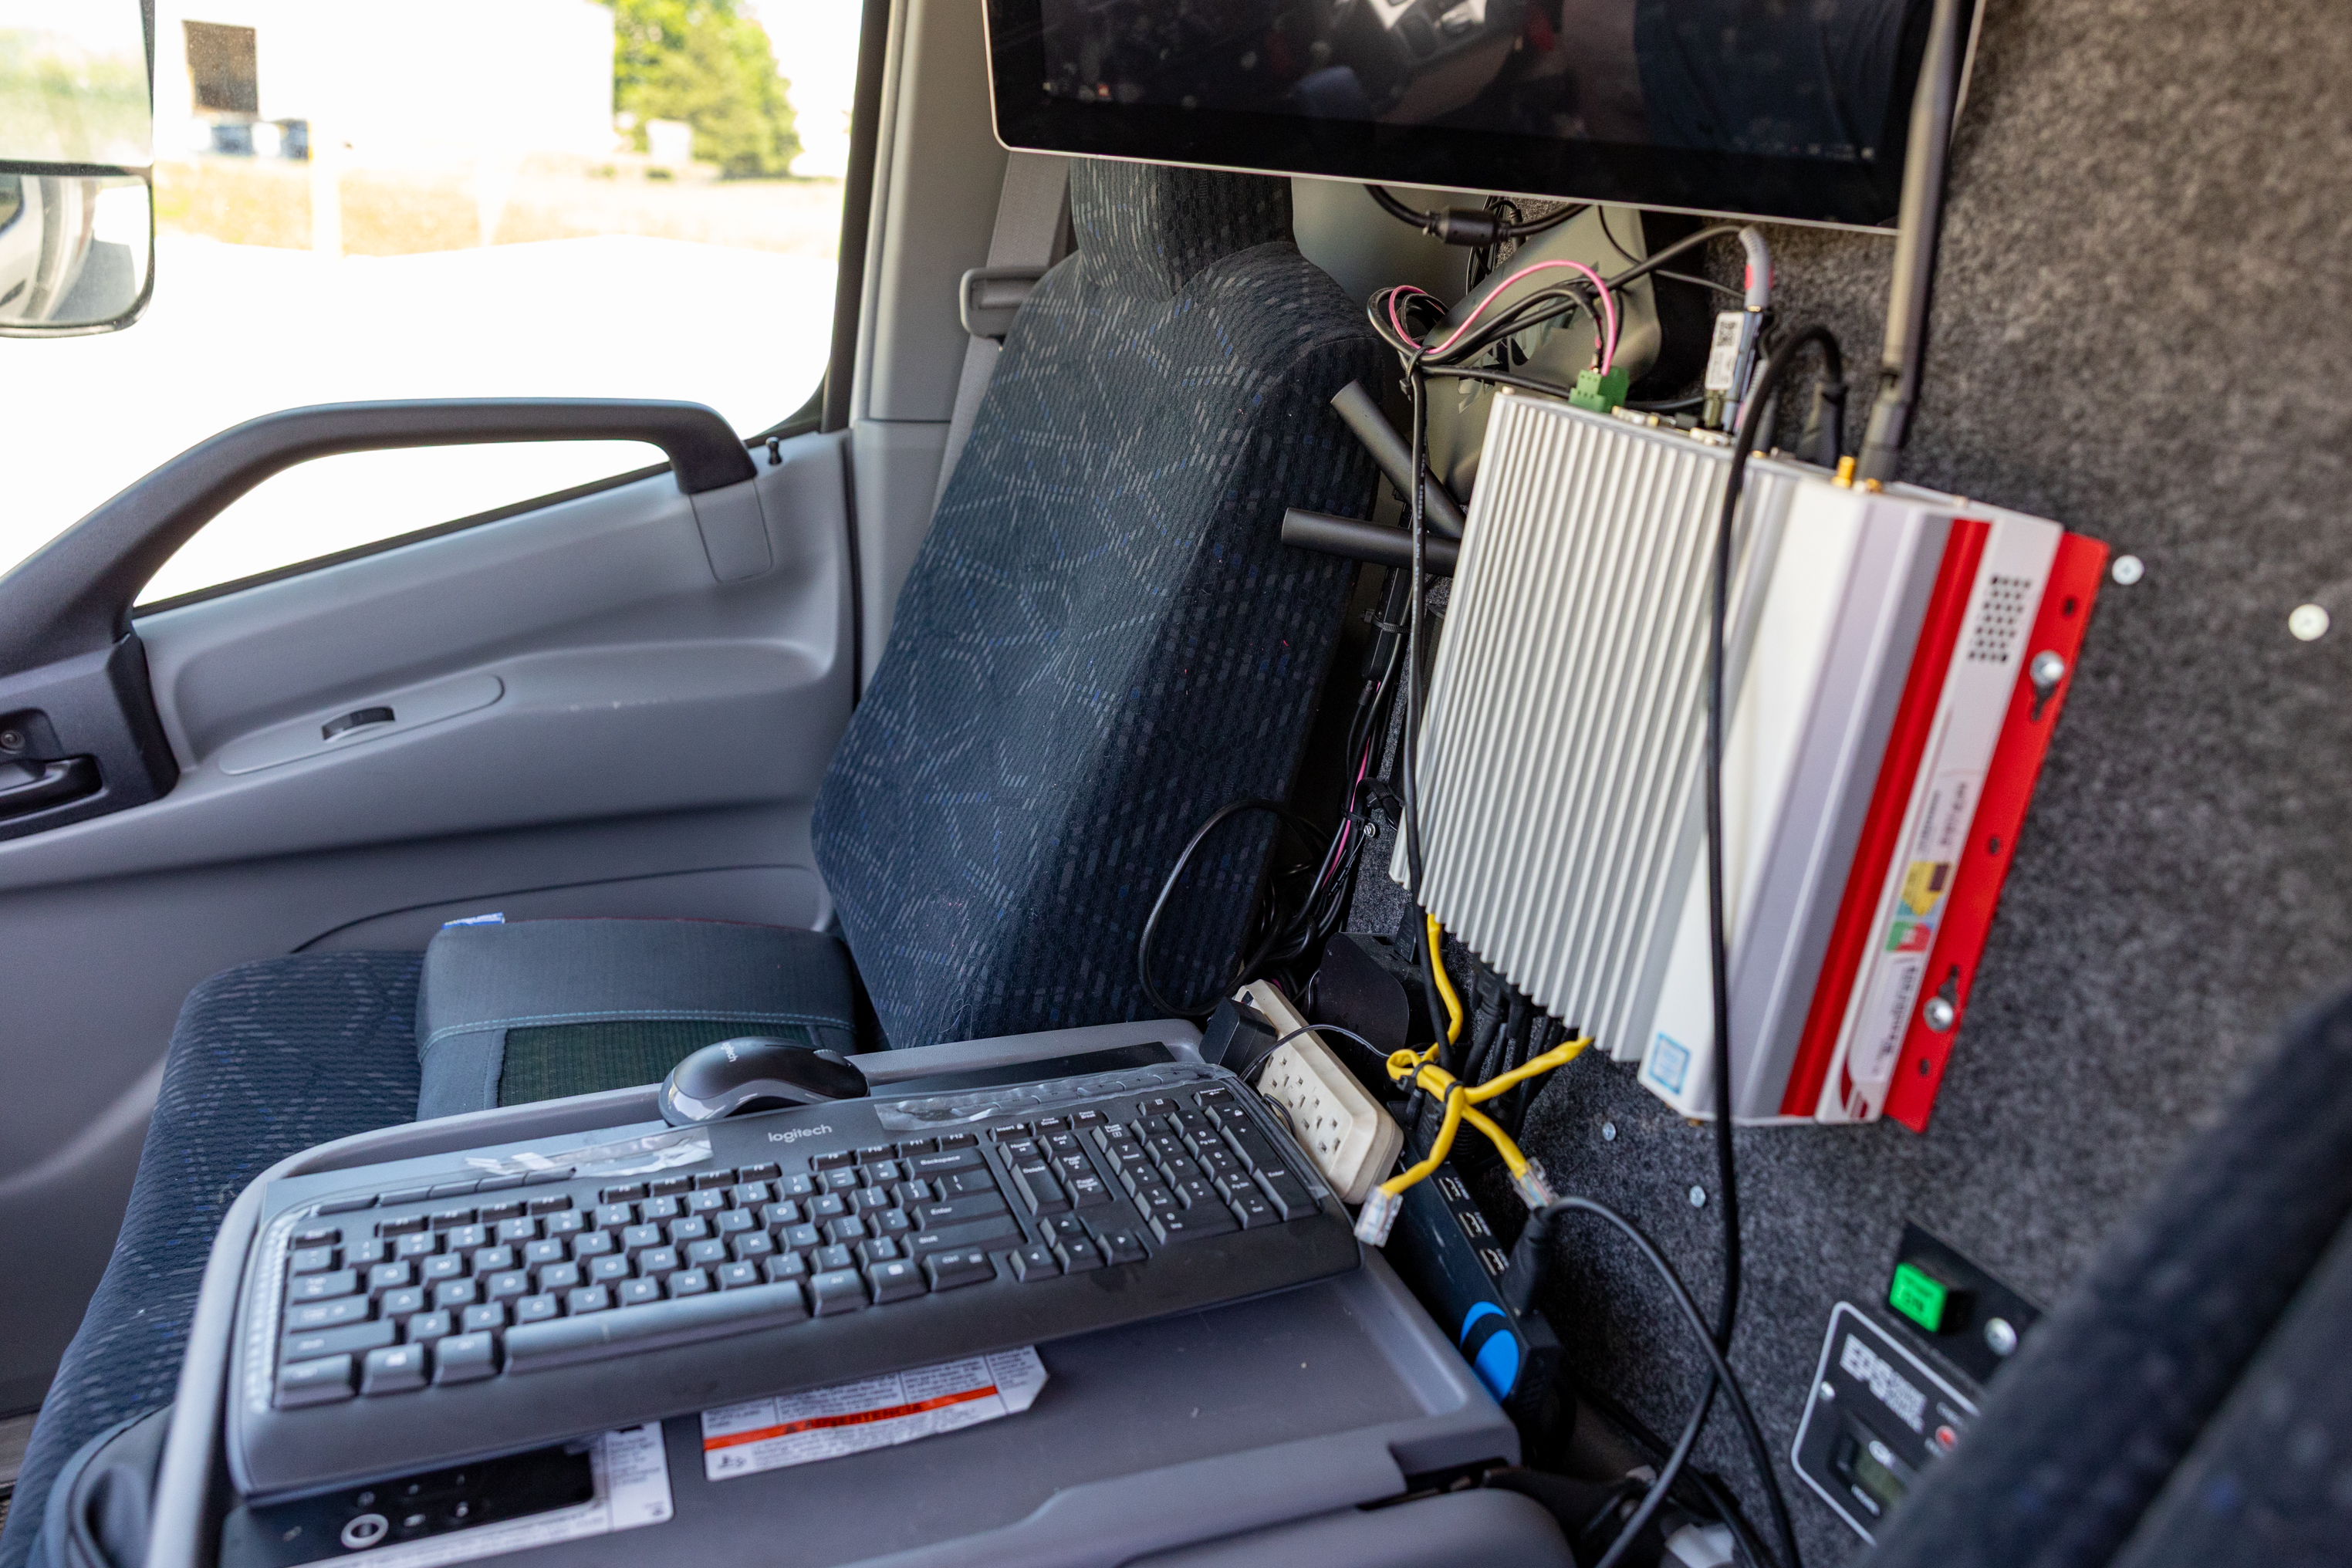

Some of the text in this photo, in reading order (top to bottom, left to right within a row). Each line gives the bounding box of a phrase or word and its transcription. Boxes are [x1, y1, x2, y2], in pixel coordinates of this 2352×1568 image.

[768, 1124, 833, 1143] logitech
[920, 1155, 961, 1166] Backspace
[1022, 1165, 1046, 1174] Delete
[822, 1199, 831, 1208] P
[930, 1206, 952, 1215] Enter
[684, 1222, 696, 1232] U
[749, 1237, 761, 1247] K
[705, 1245, 714, 1255] J
[684, 1275, 697, 1286] N
